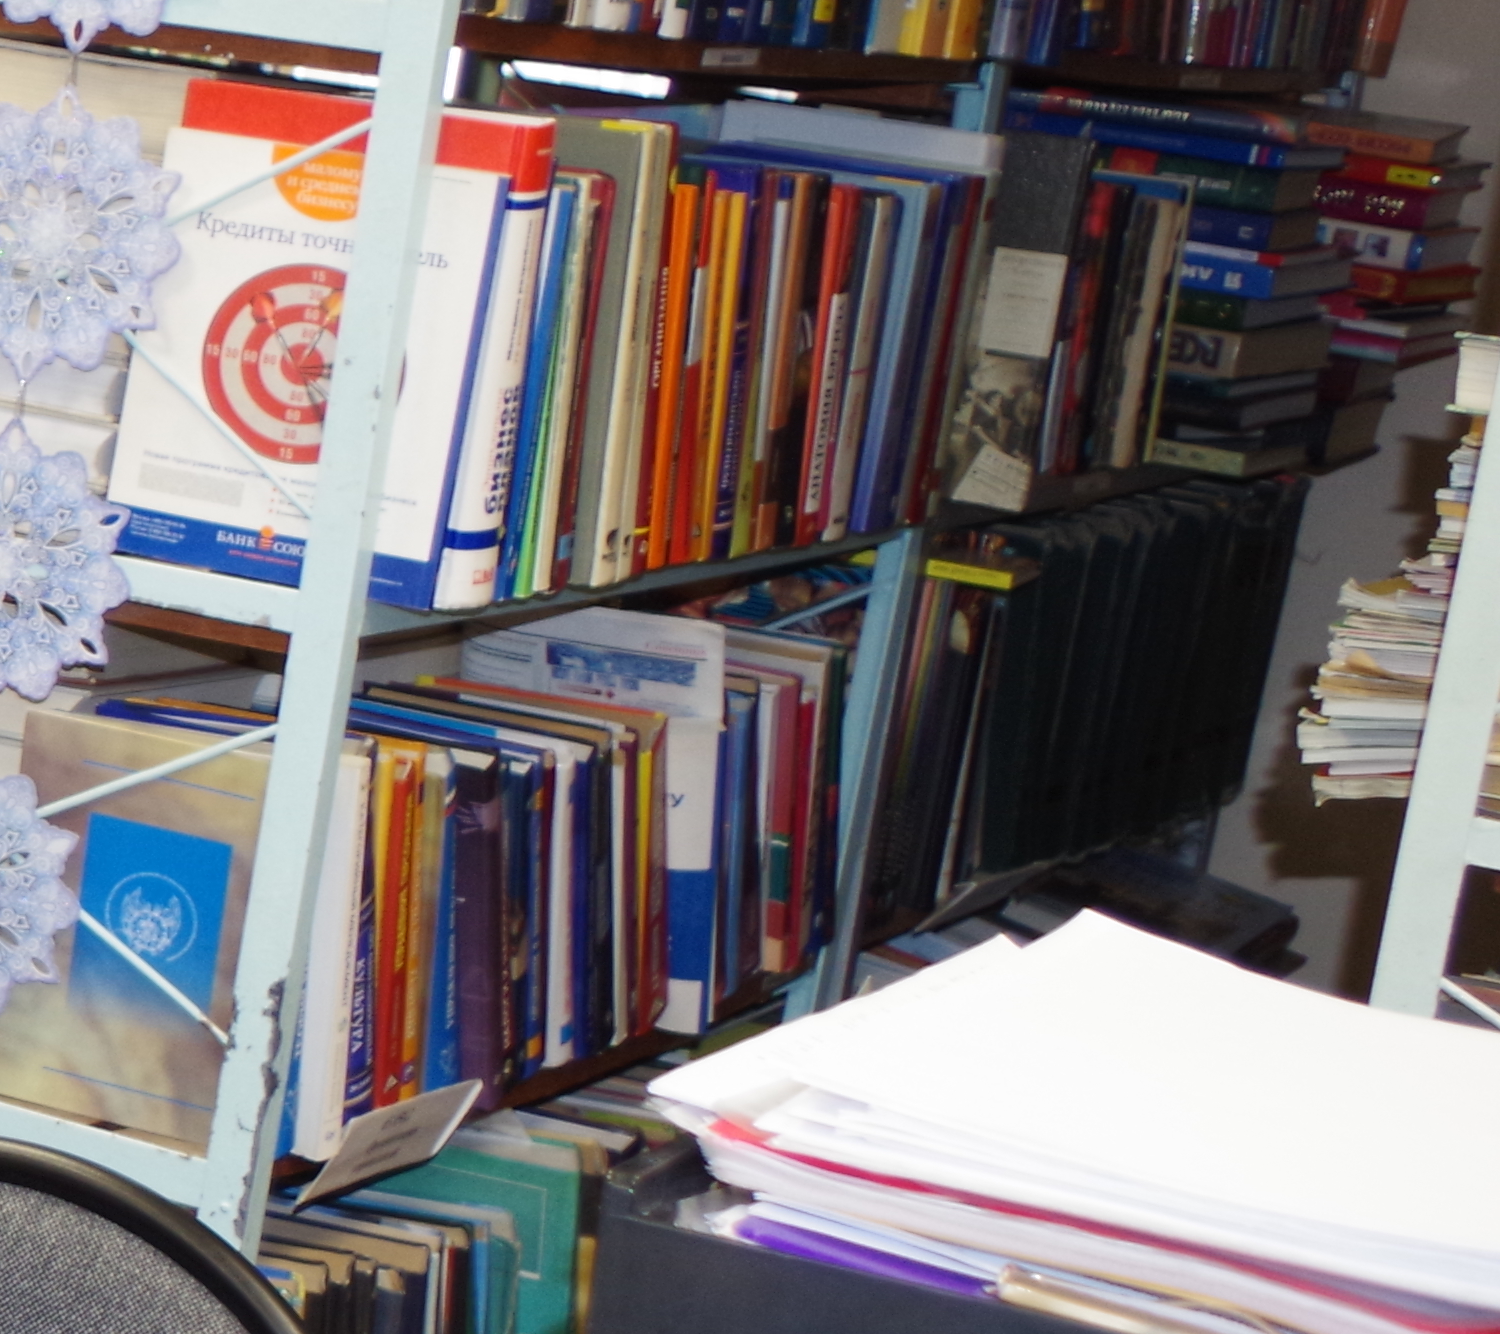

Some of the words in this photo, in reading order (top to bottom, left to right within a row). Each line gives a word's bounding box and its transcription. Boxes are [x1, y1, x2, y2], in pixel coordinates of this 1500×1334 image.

[196, 210, 295, 248] Кредиты
[311, 270, 327, 283] 15
[206, 343, 221, 357] 15
[278, 447, 294, 460] 15
[215, 529, 257, 548] БАНК
[349, 955, 367, 1054] КУЛЬТУРА
